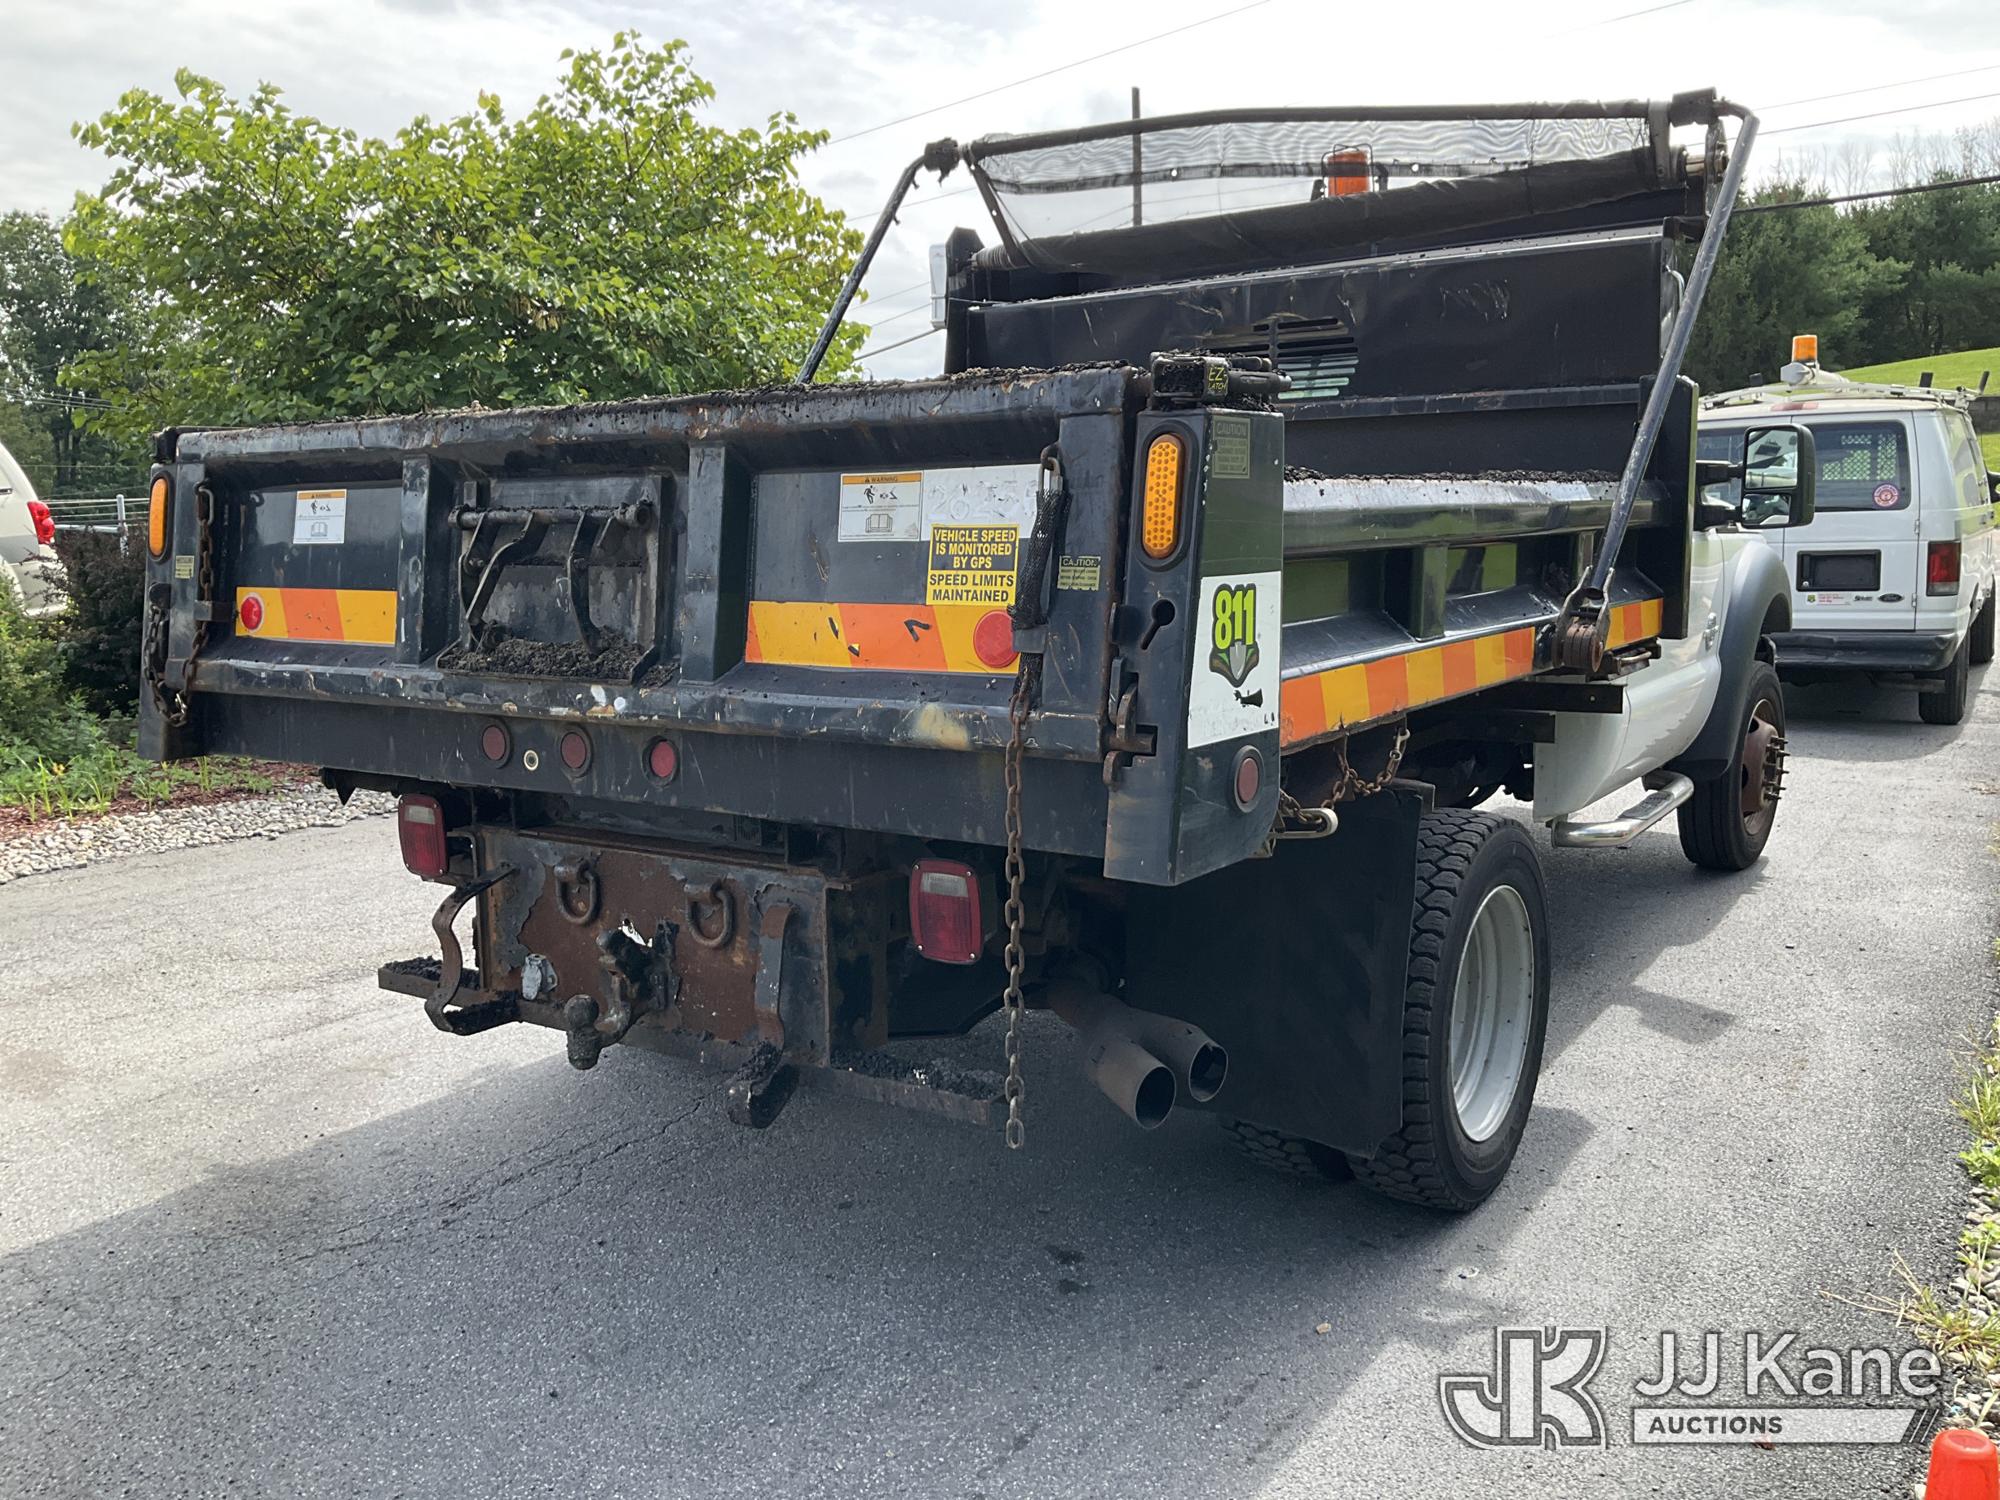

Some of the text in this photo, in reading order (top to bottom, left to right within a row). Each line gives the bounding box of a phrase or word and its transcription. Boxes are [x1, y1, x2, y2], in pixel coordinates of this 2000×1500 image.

[1216, 423, 1247, 436] CAUTION
[934, 529, 1016, 542] VEHICLE SPEED
[936, 543, 1012, 555] IS MONITORED
[953, 556, 992, 568] BY GPS
[929, 574, 1014, 587] SPEED LIMITS
[932, 589, 1009, 602] MAINTAINED
[1215, 589, 1255, 650] 811
